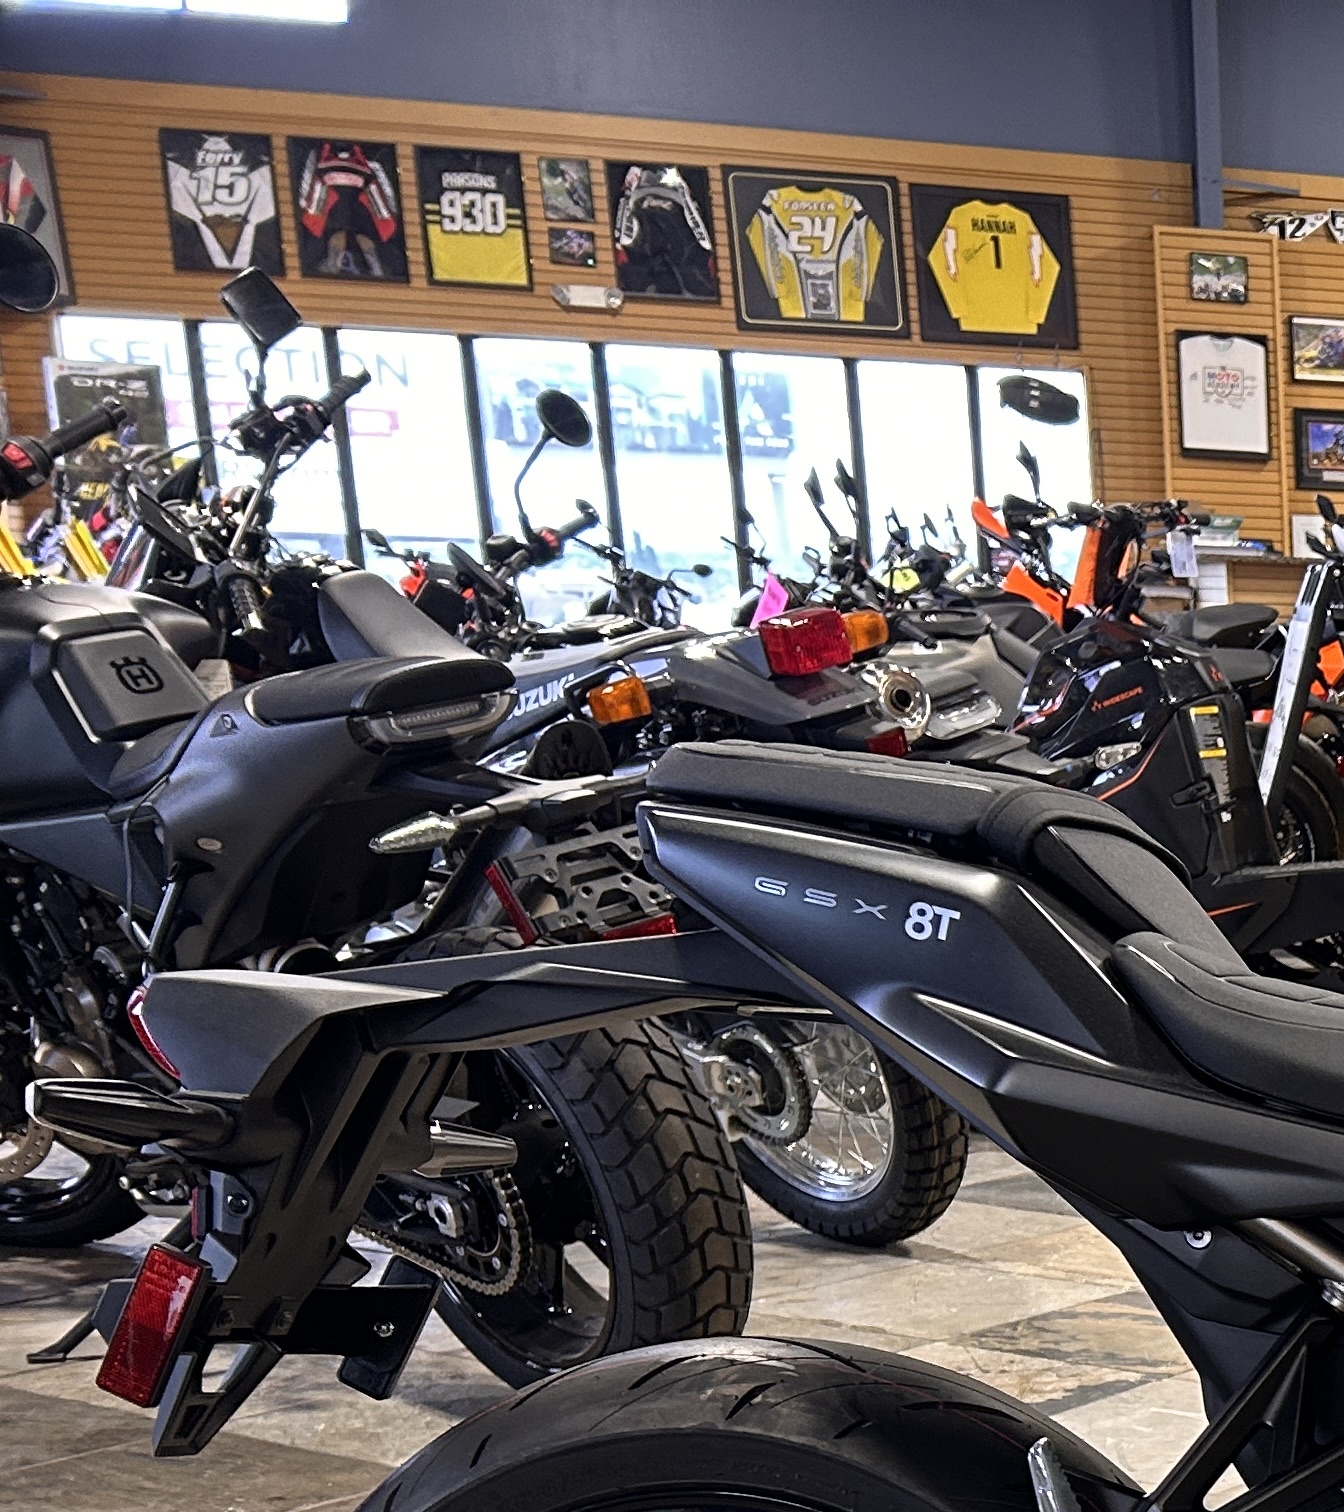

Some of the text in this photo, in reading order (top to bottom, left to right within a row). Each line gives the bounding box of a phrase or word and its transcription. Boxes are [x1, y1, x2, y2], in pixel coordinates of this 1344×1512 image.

[190, 166, 250, 206] 15
[441, 171, 498, 190] PARSONS
[440, 190, 507, 235] 930
[970, 216, 1017, 235] HANNAH
[787, 214, 837, 254] 24
[990, 235, 1003, 270] 1
[904, 901, 961, 941] 8T
